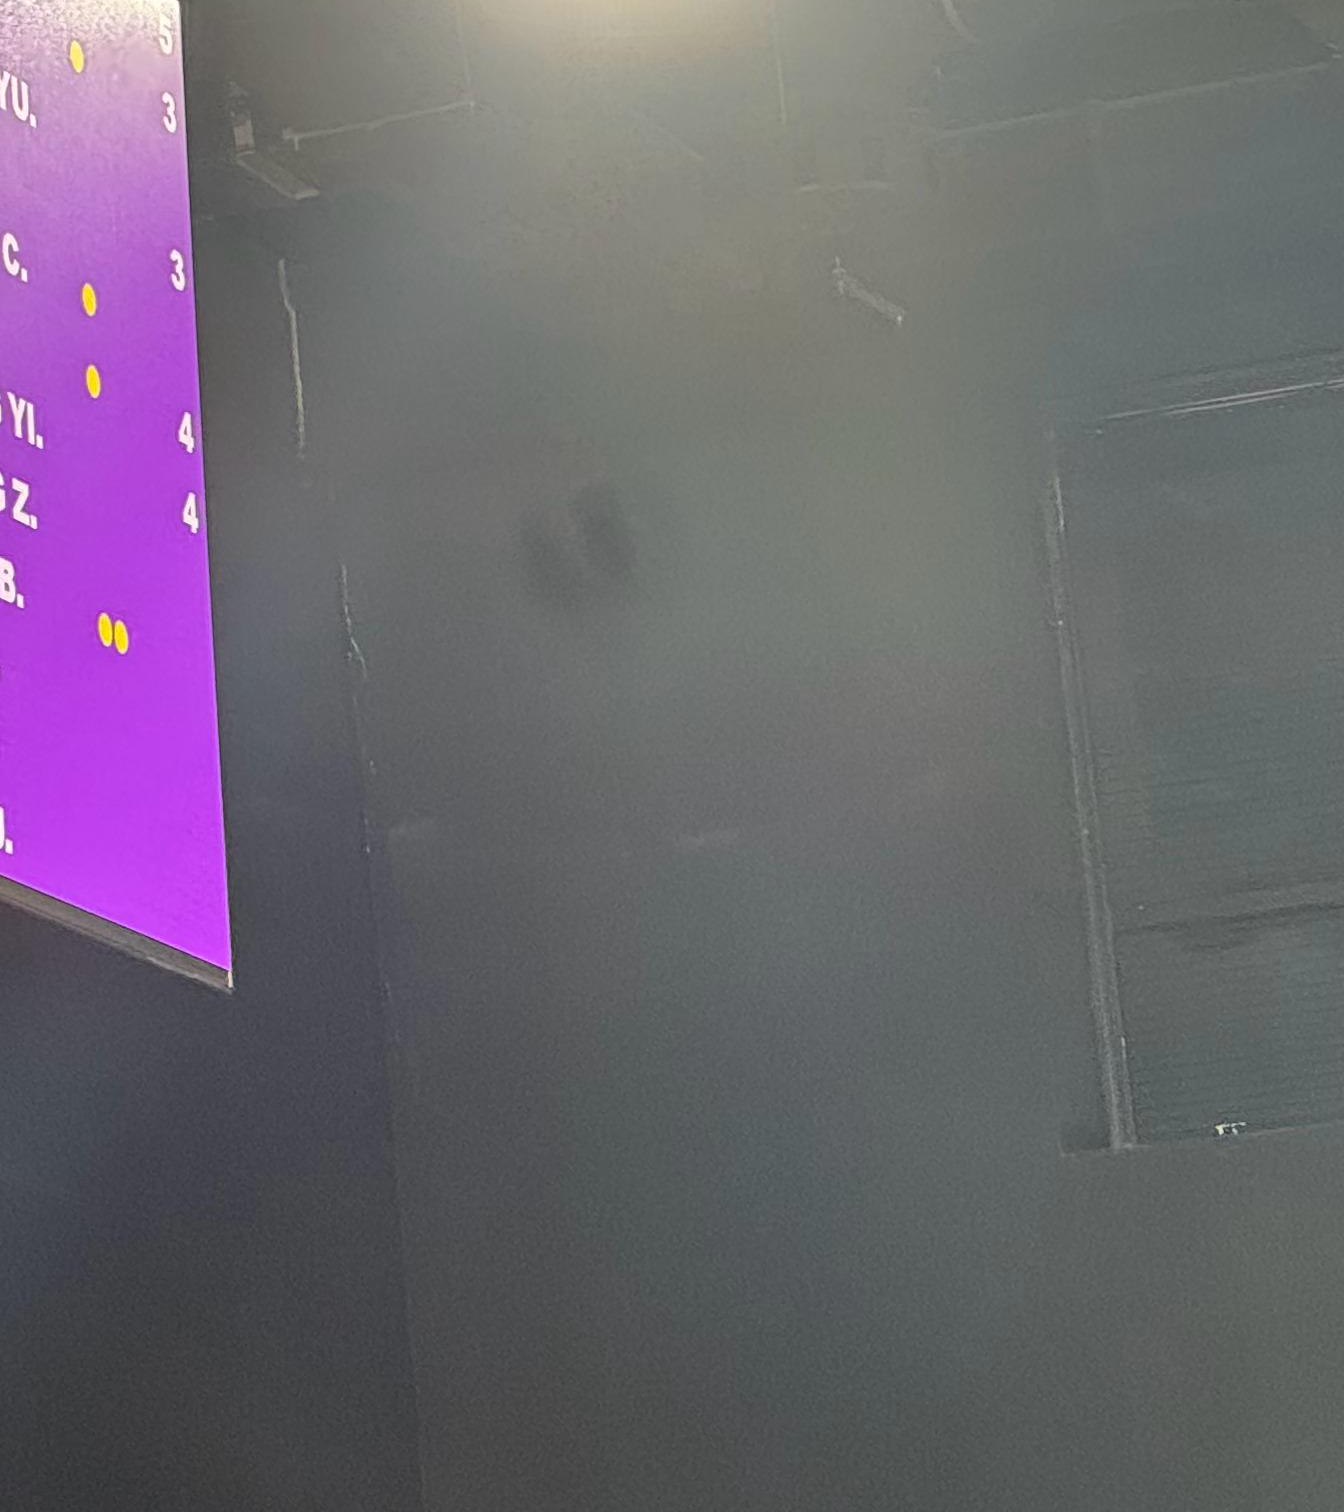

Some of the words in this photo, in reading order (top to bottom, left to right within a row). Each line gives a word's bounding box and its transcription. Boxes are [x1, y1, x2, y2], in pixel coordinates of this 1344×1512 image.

[159, 12, 174, 55] 5
[162, 92, 177, 134] 3
[3, 232, 28, 283] C.
[170, 249, 185, 292] 3
[6, 390, 44, 450] YI.
[178, 412, 194, 453] 4
[12, 479, 38, 529] Z.
[182, 492, 198, 534] 4
